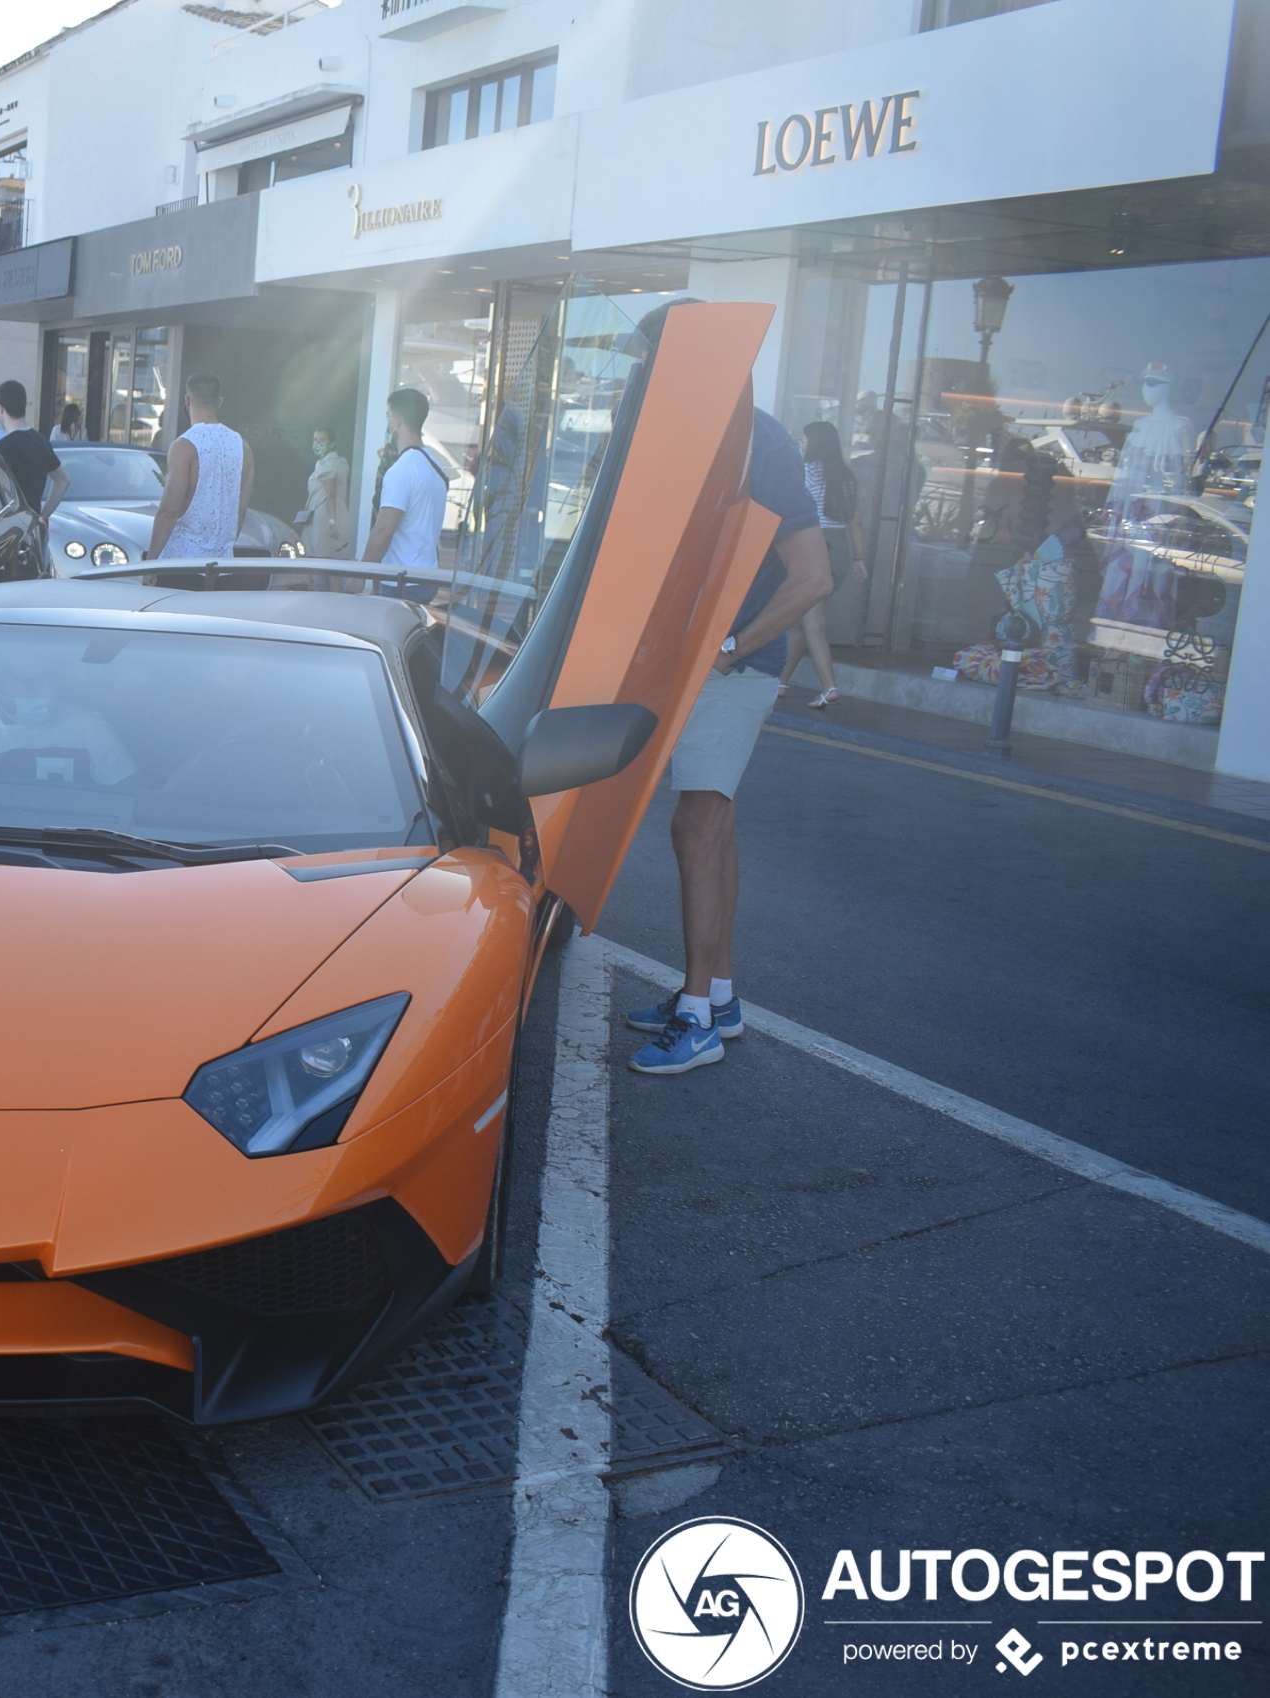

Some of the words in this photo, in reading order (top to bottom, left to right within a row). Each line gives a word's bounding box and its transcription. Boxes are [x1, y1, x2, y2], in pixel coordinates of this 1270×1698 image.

[753, 90, 920, 176] LOEWE
[347, 183, 443, 239] BILLIONAIRE
[130, 251, 152, 276] TOM
[152, 245, 183, 270] FORD
